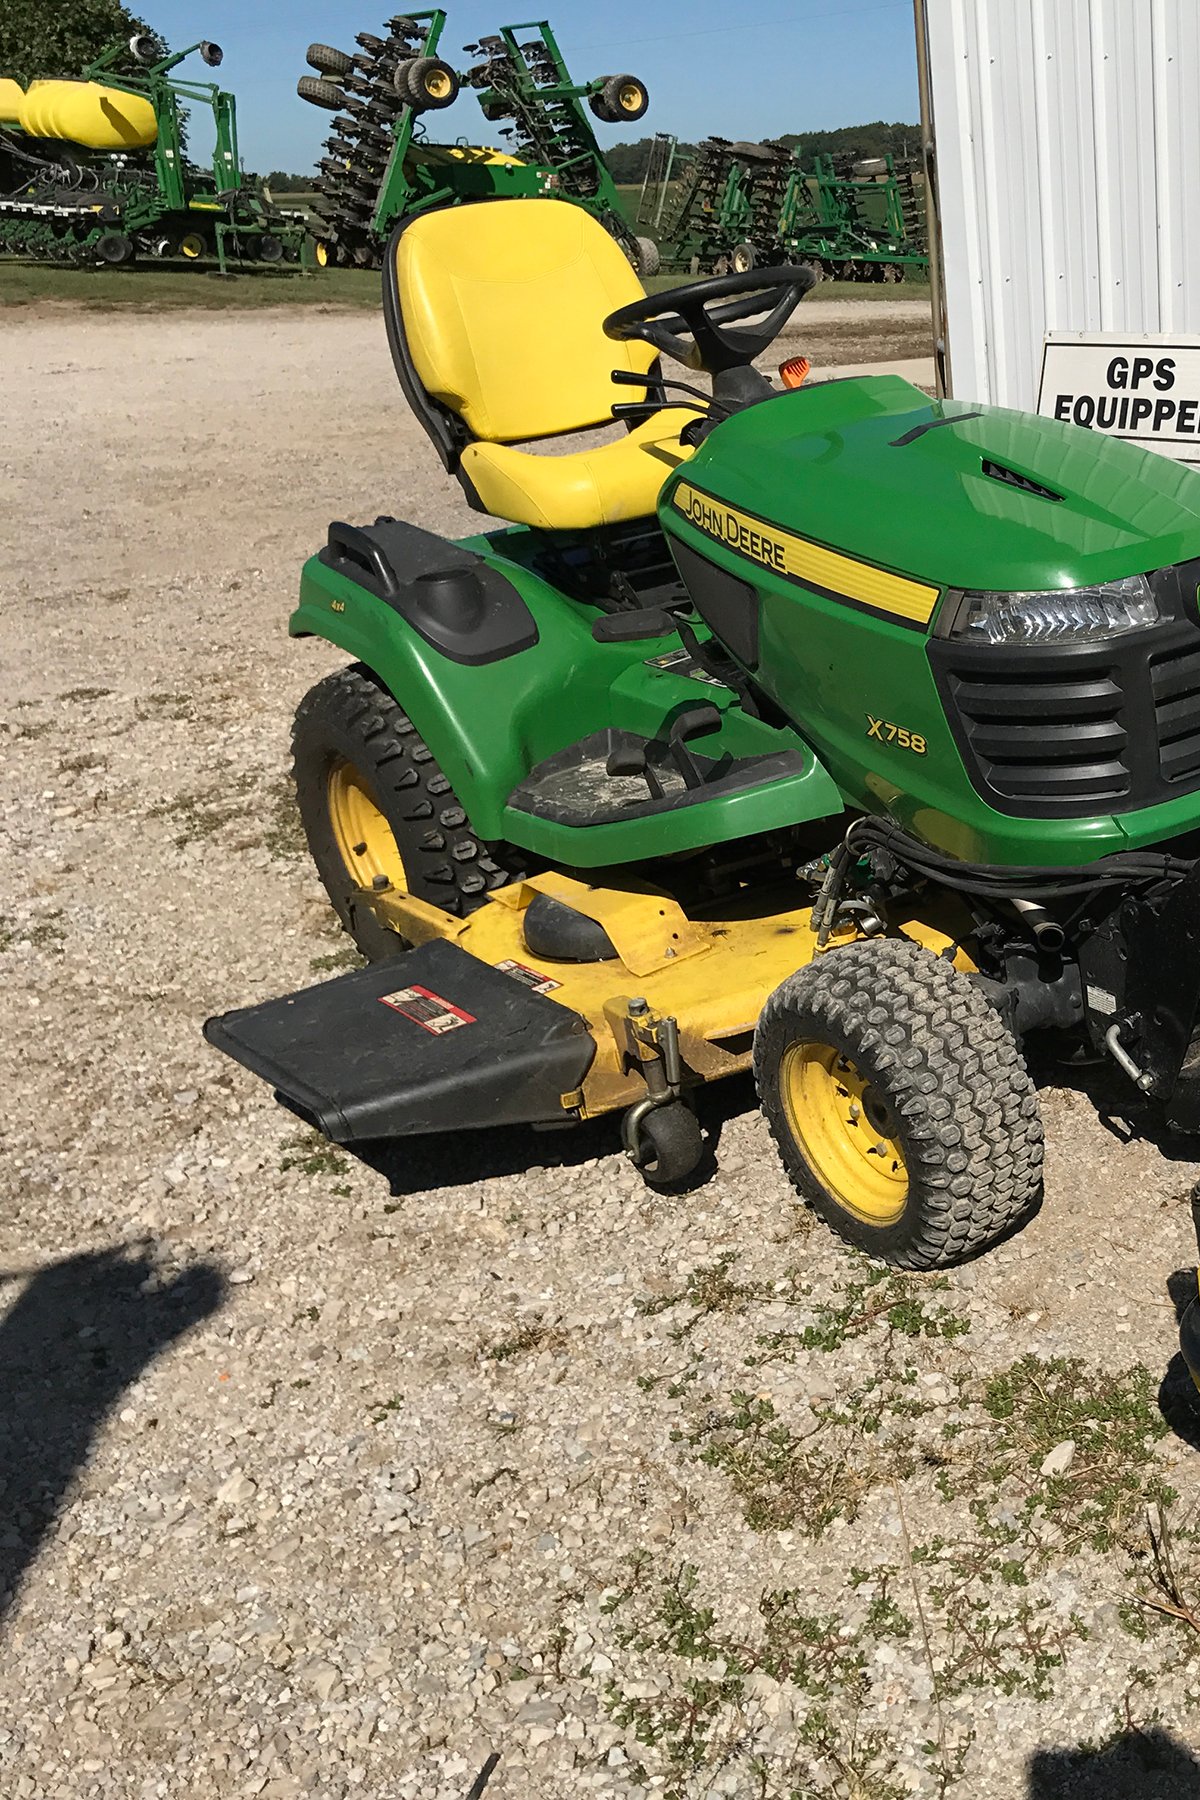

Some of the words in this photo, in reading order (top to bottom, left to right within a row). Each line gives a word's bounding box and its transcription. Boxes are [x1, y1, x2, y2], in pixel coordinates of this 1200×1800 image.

[1106, 356, 1176, 391] GPS
[684, 489, 724, 539] JOHN
[726, 512, 787, 572] DEERE
[866, 714, 927, 754] X758
